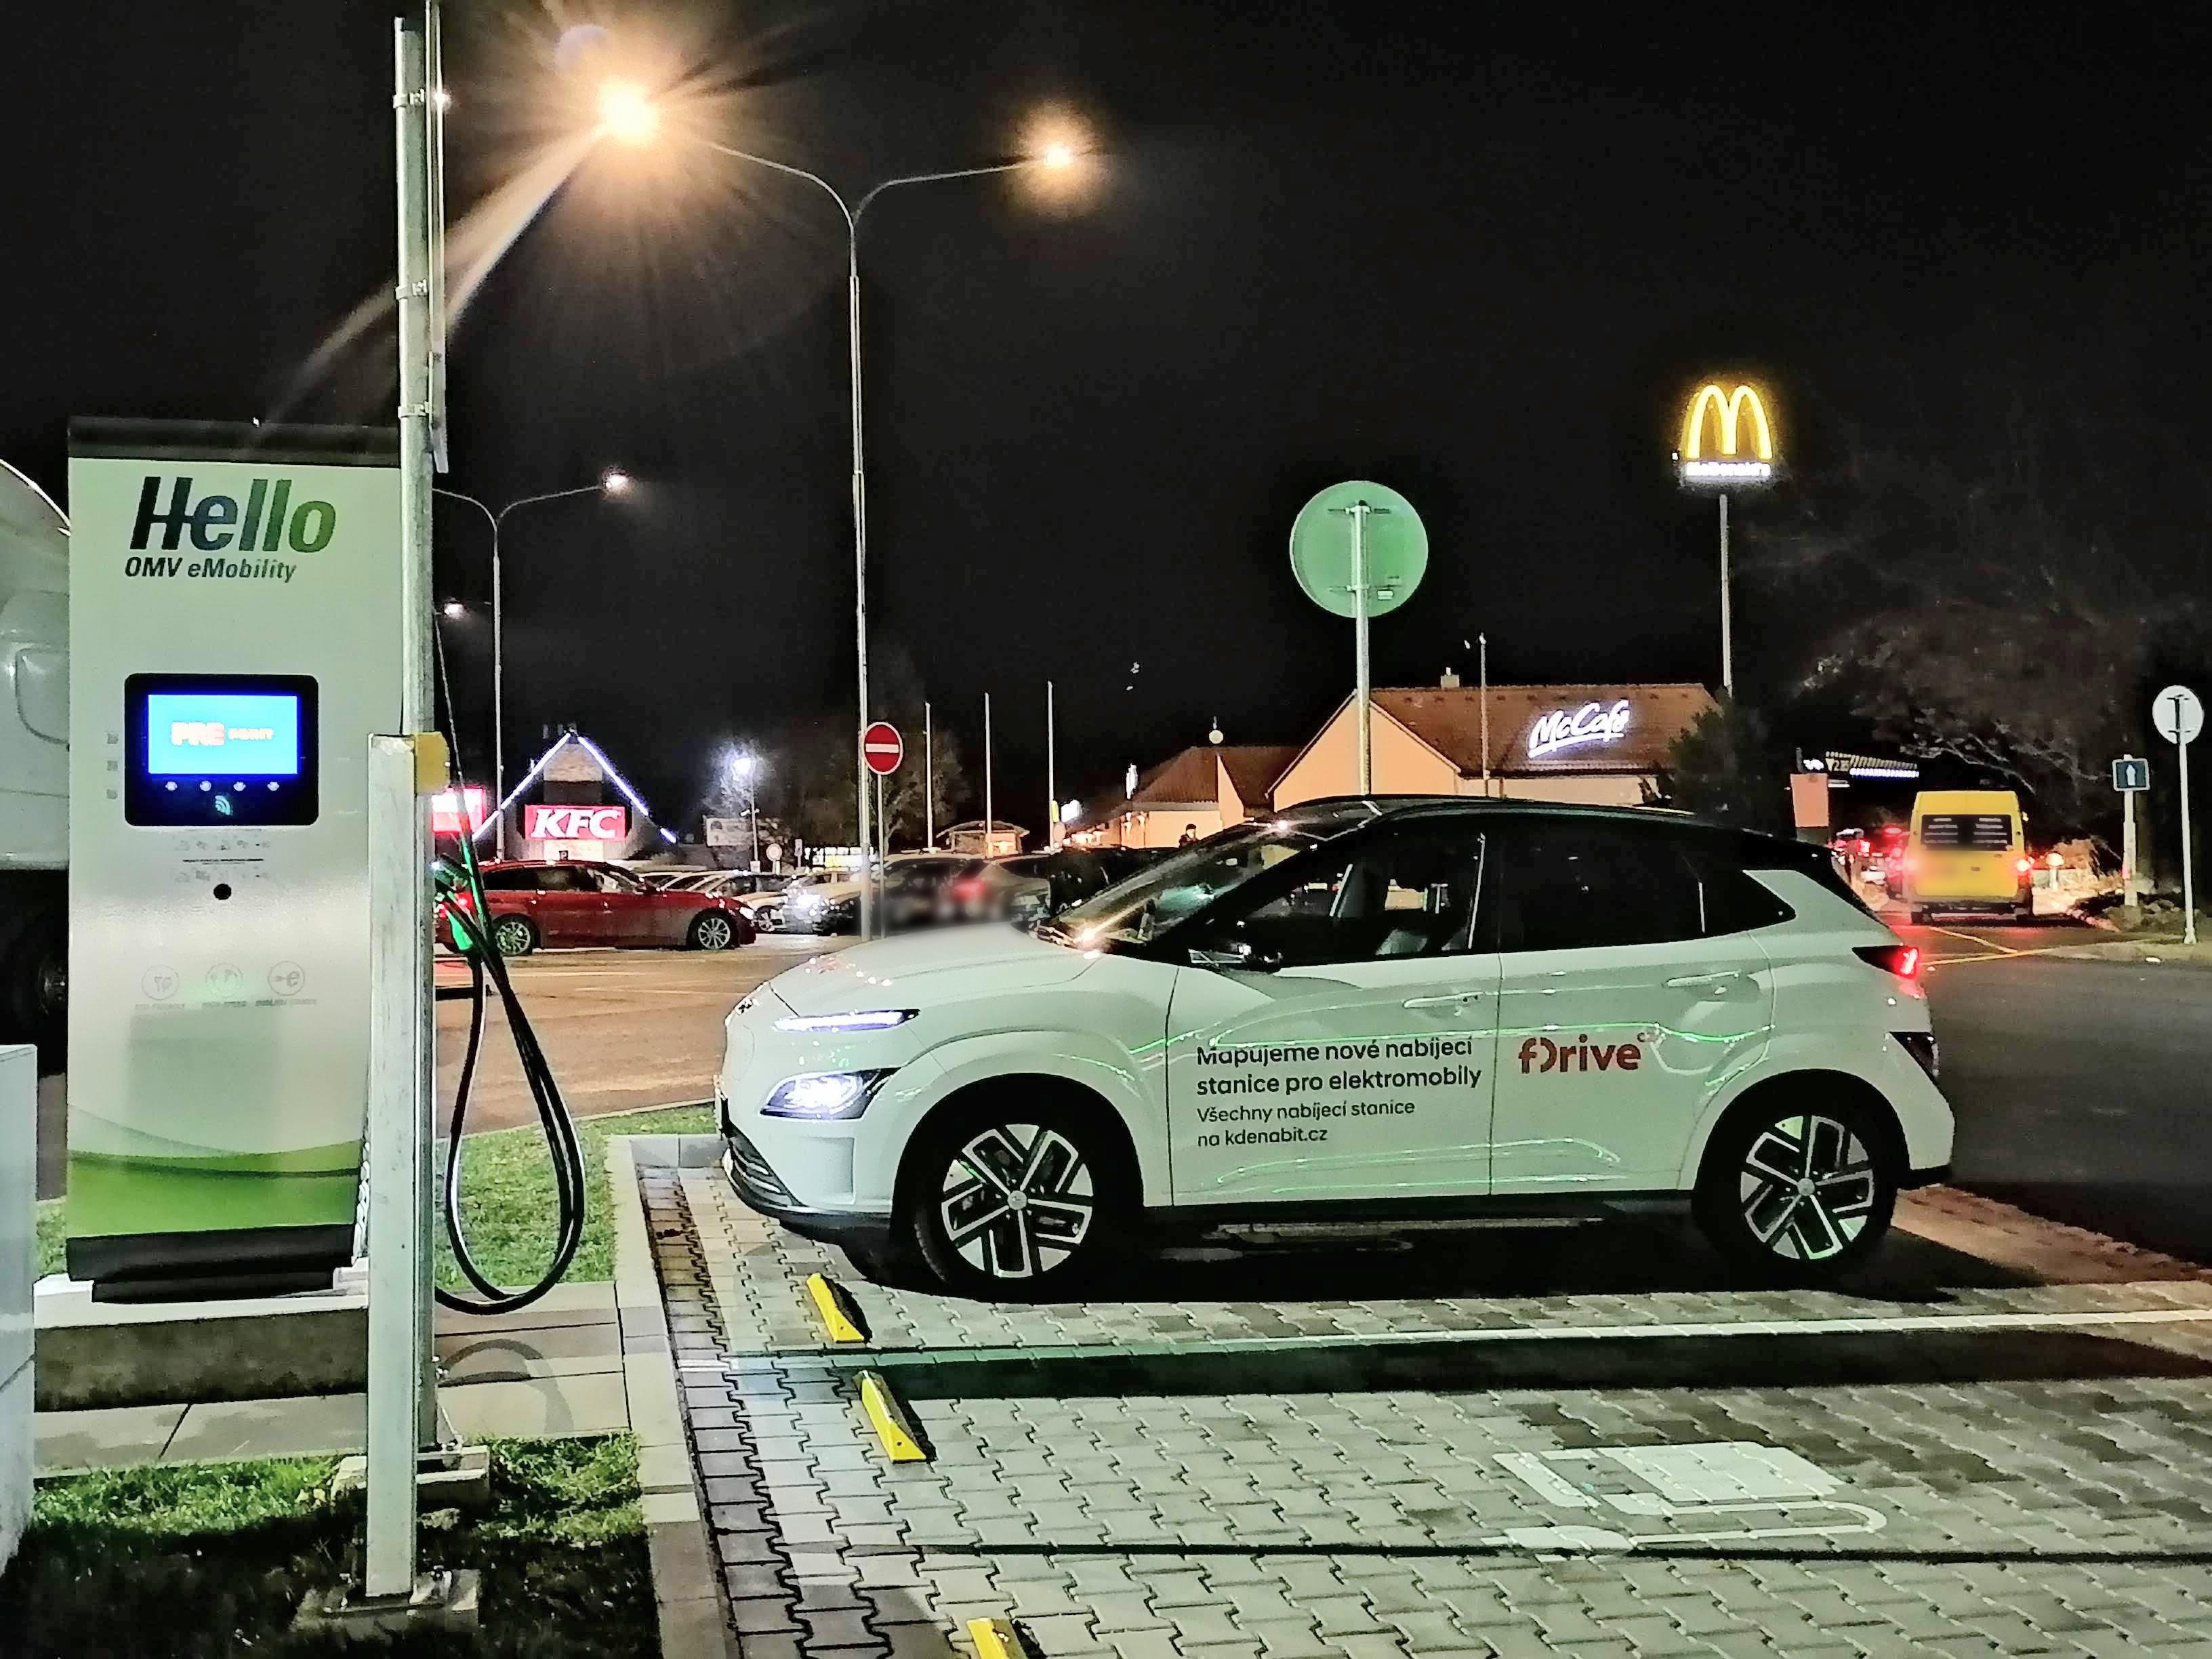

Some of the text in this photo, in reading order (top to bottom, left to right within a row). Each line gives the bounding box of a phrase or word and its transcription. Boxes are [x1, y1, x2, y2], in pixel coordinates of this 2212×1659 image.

[130, 476, 336, 553] Hello
[125, 556, 297, 583] OMV eMobility
[531, 808, 621, 839] KFC
[1197, 1046, 1320, 1068] Mapujeme
[1325, 1040, 1380, 1061] nové
[1197, 1065, 1482, 1096] stanice pro elektromobily
[1197, 1105, 1273, 1123] Všechny
[1351, 1099, 1416, 1116] stanice
[1197, 1126, 1328, 1147] na kdenabit.cz
